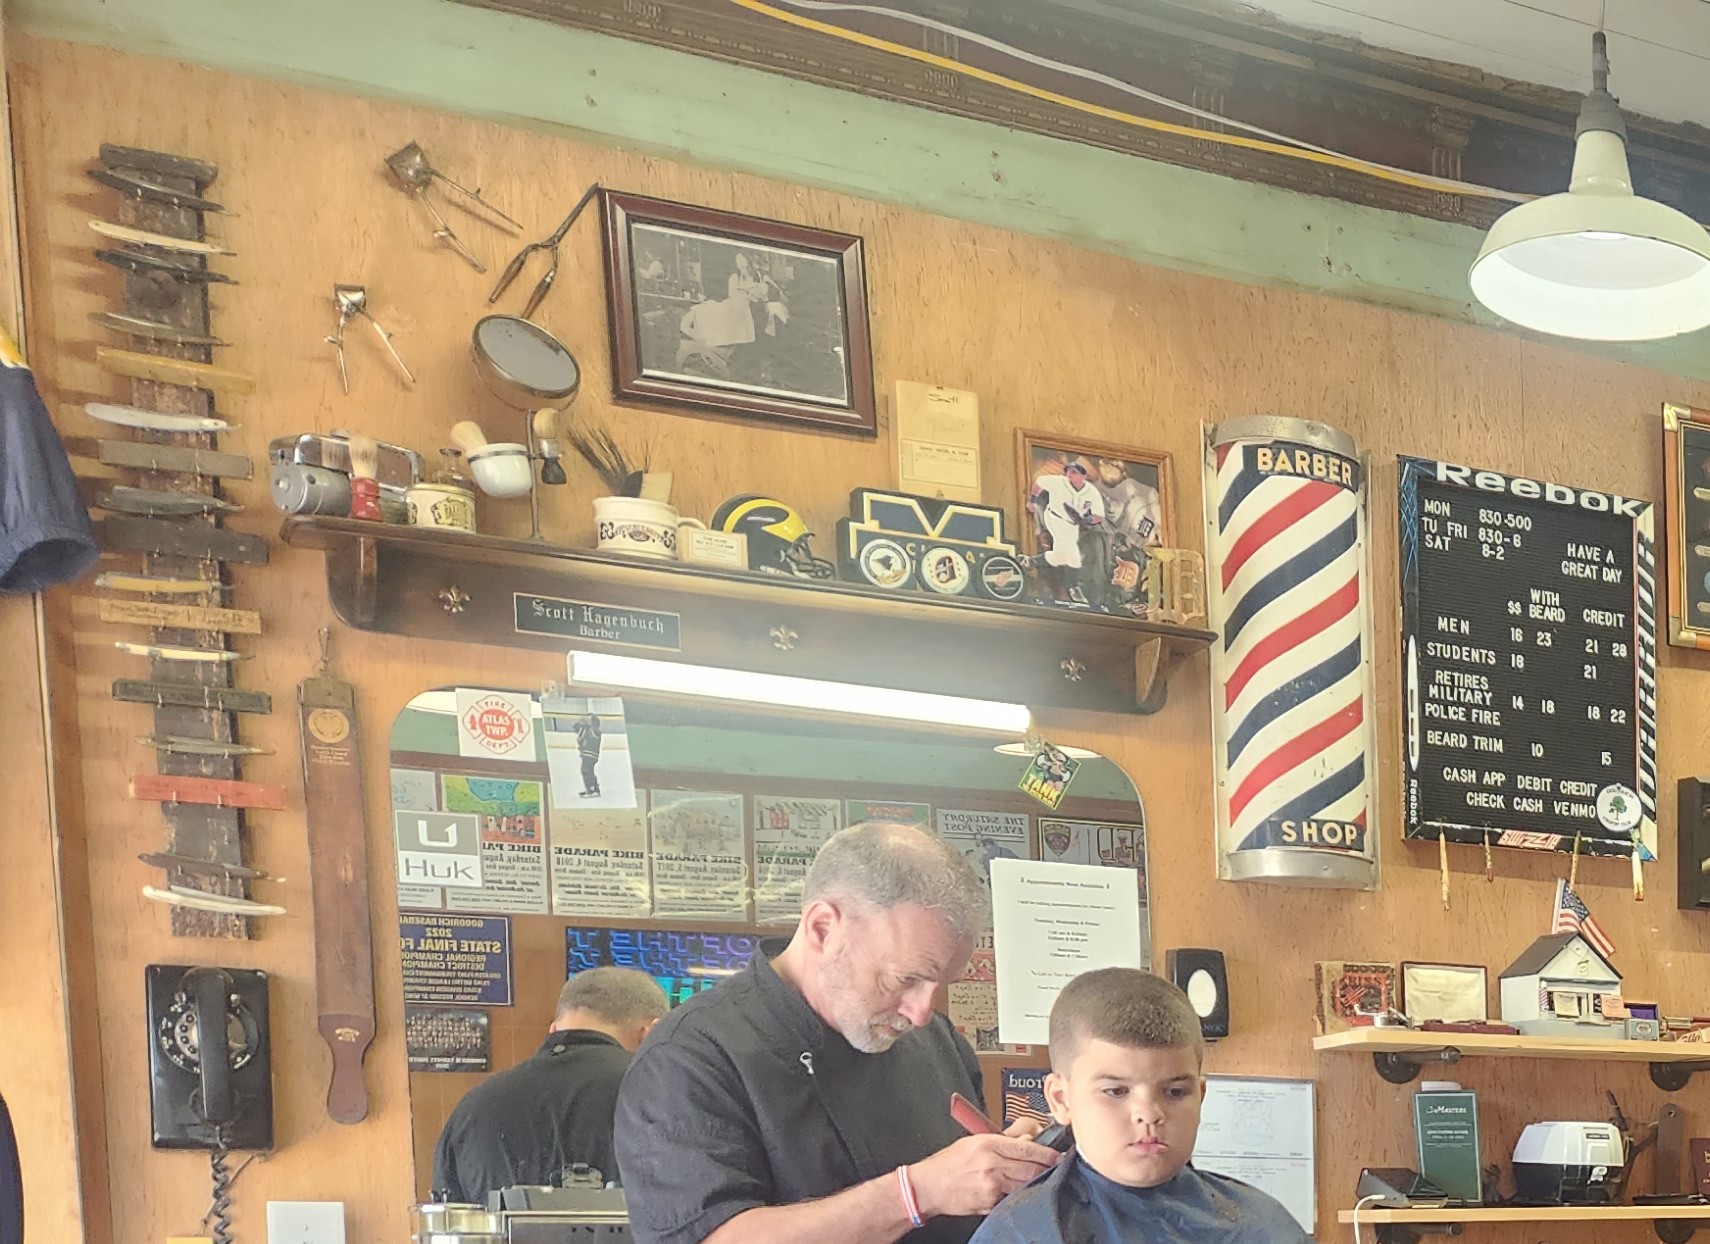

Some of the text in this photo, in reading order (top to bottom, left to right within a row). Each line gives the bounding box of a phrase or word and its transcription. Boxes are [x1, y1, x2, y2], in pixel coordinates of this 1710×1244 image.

[1257, 447, 1353, 487] BARBER
[1436, 461, 1639, 519] Reebok
[1424, 499, 1451, 518] MON
[1421, 516, 1468, 539] TU FRI
[1424, 534, 1451, 551] SAT
[1481, 543, 1505, 560] 8-2
[1567, 542, 1615, 564] HAVE A
[1561, 560, 1622, 584] GREAT DAY
[1530, 588, 1560, 607] WITH
[531, 598, 654, 634] Scott Hagenbuch
[1507, 600, 1522, 616] $$
[1529, 604, 1566, 623] BEARD
[1437, 616, 1470, 635] MEN
[1582, 608, 1625, 628] CREDIT
[579, 624, 621, 640] Barber
[1510, 627, 1551, 647] 16 23
[1426, 641, 1496, 665] STUDENTS
[1585, 639, 1627, 658] 21 28
[1435, 669, 1489, 690] RETIRES
[1583, 664, 1597, 680] 21
[484, 700, 506, 709] FIRE
[1428, 684, 1493, 706] MILITARY
[1512, 695, 1555, 714] 14 18
[482, 713, 511, 724] ATLAS
[1425, 702, 1500, 726] POLICE FIRE
[1587, 705, 1626, 724] 18 22
[485, 725, 509, 736] TWP.
[1426, 729, 1503, 754] BEARD TRIM
[1531, 742, 1544, 758] 10
[1601, 751, 1612, 766] 15
[1442, 766, 1598, 798] CASH APP DEBIT CREDIT
[1466, 791, 1596, 819] CHECK CASH VENMO
[1281, 820, 1358, 846] SHOP
[404, 857, 475, 880] Huk
